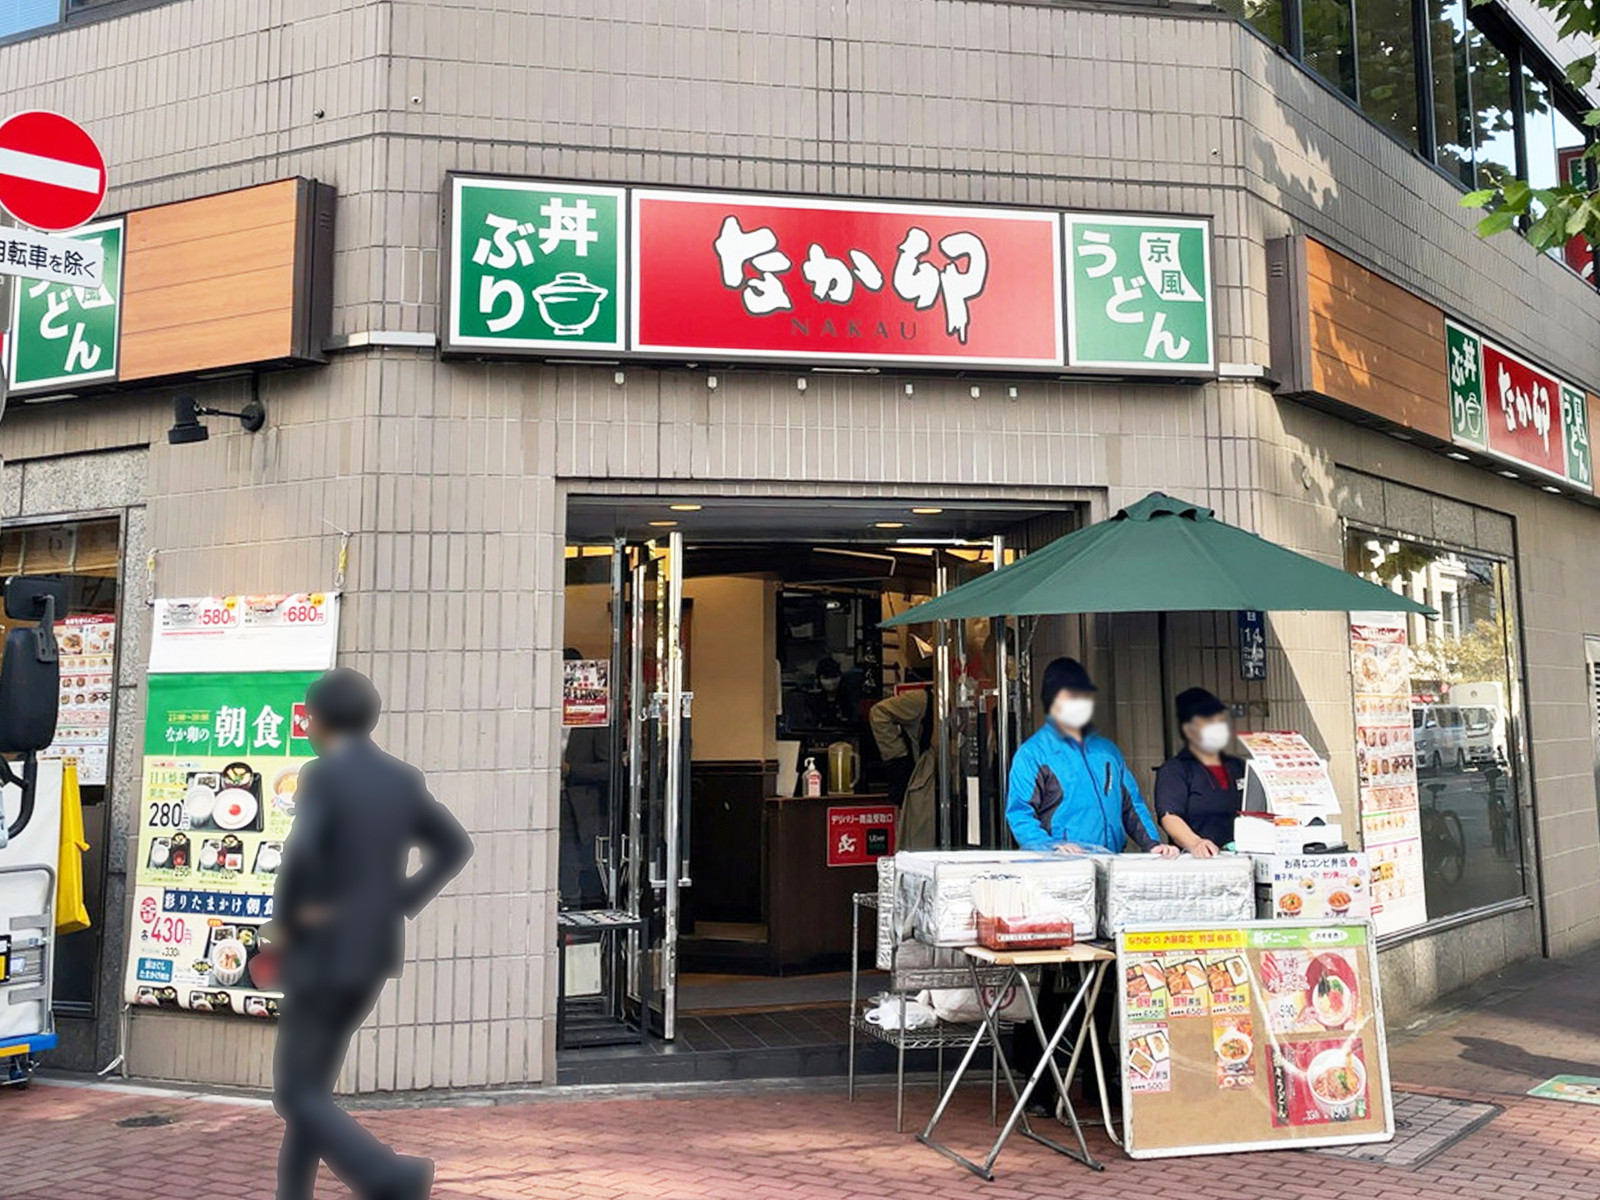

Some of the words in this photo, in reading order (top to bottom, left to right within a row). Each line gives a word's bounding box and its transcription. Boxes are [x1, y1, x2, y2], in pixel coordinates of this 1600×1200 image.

[1147, 237, 1185, 295] 京風
[1078, 230, 1190, 360] うどん
[790, 318, 917, 340] NAKAU
[214, 705, 284, 748] 朝食
